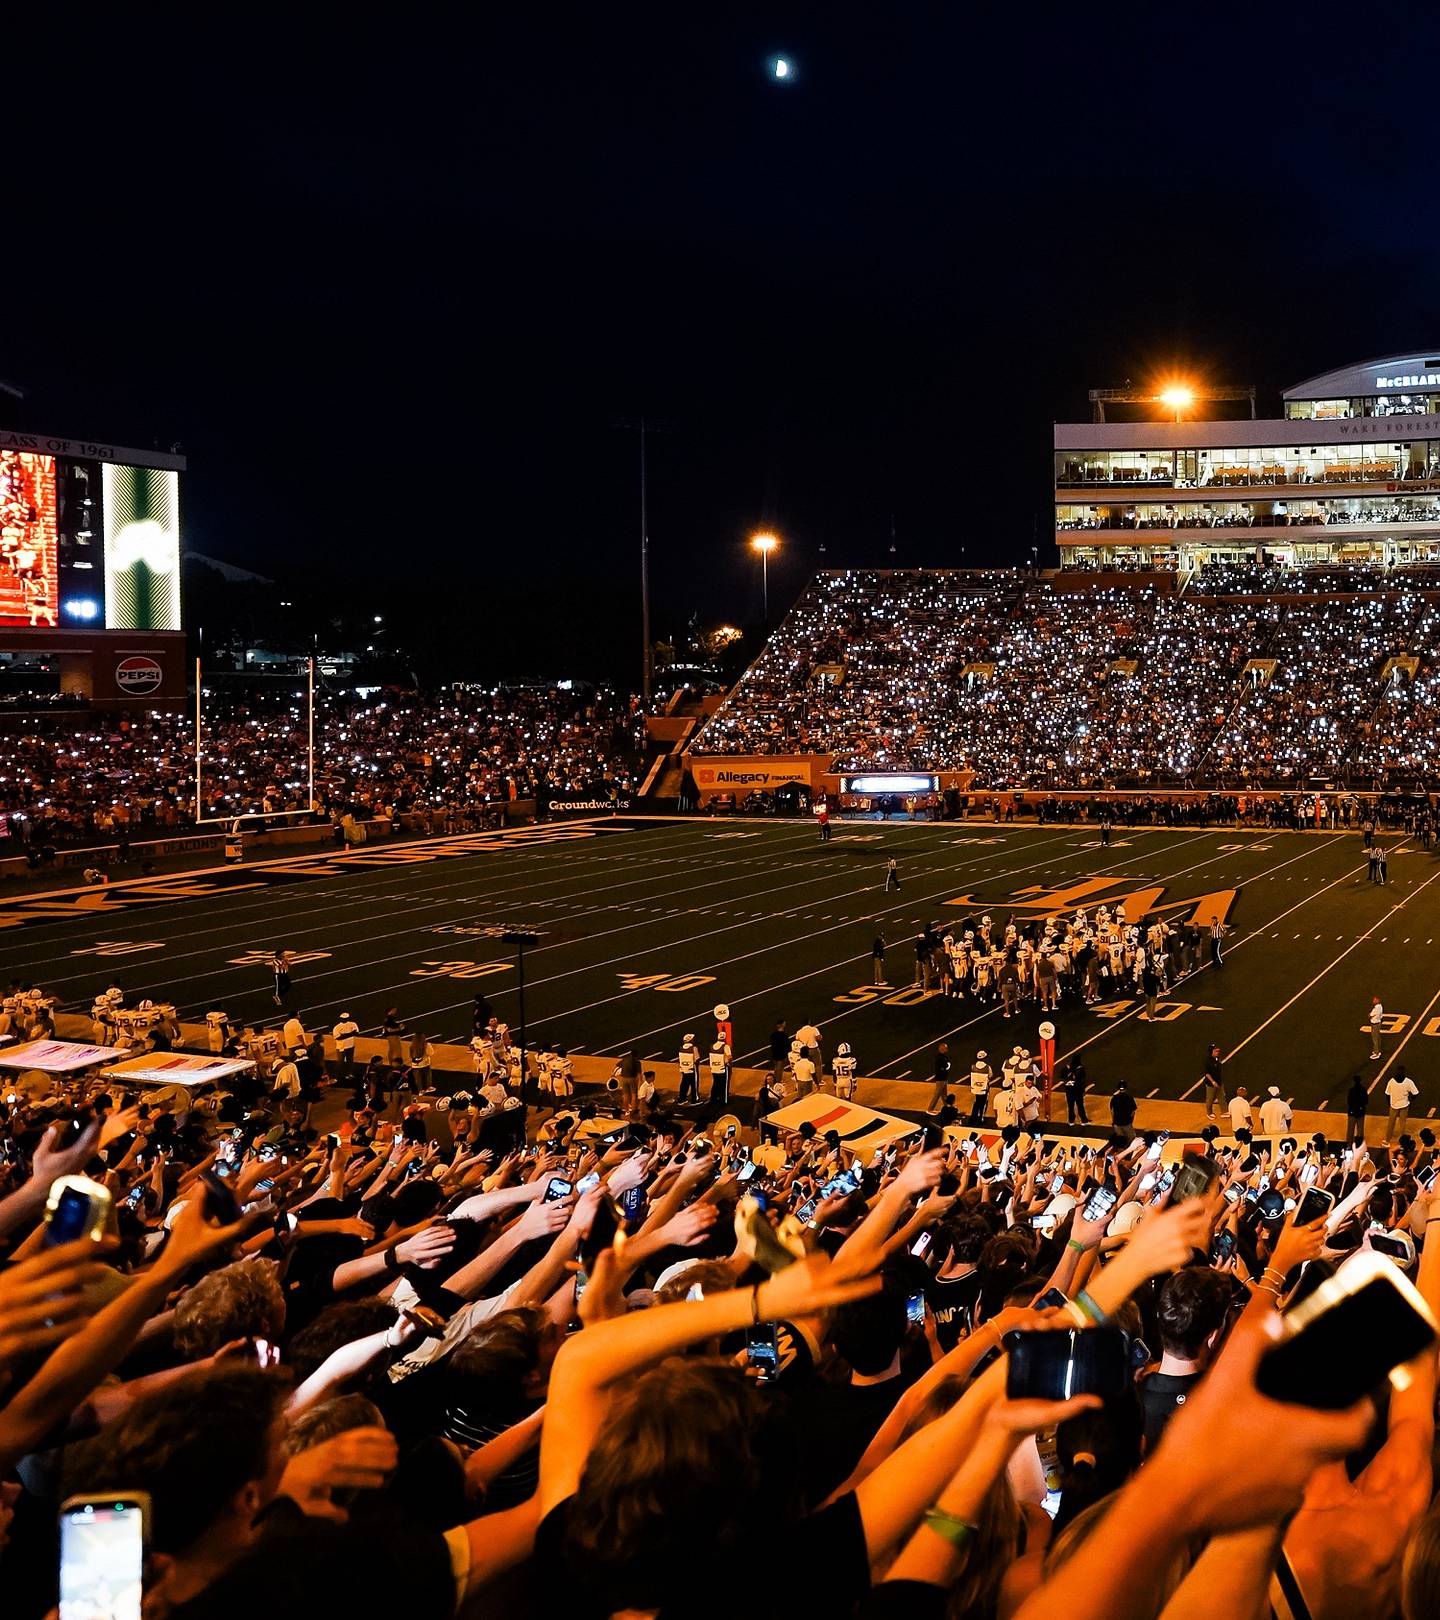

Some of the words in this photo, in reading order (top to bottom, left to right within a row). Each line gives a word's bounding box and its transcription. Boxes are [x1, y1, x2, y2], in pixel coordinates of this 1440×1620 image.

[1340, 424, 1377, 434] WAKE
[1386, 421, 1440, 432] FOREST
[47, 440, 70, 452] OF
[80, 447, 114, 459] 1961
[118, 671, 160, 680] PEPSI
[717, 770, 770, 785] Allegacy
[0, 882, 273, 928] AKE
[832, 985, 943, 1006] 50
[1088, 999, 1193, 1022] 40
[836, 1066, 848, 1077] 15
